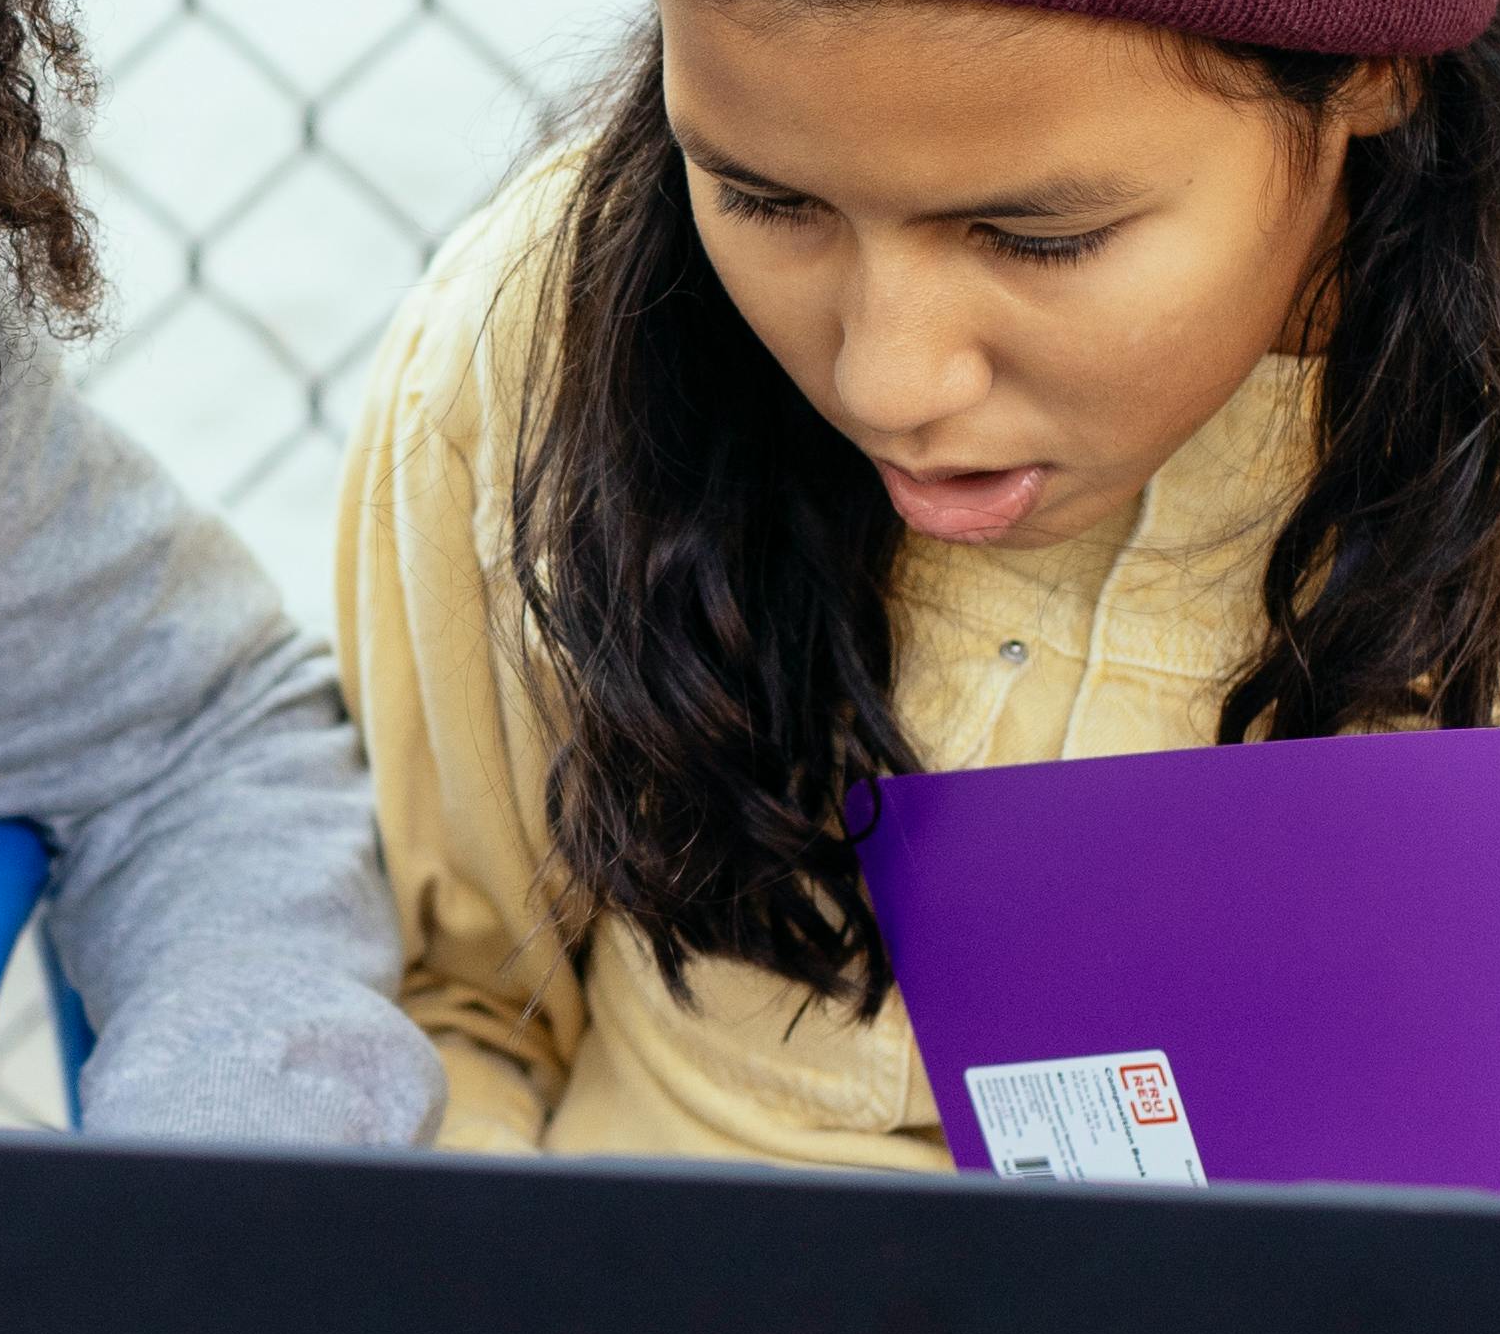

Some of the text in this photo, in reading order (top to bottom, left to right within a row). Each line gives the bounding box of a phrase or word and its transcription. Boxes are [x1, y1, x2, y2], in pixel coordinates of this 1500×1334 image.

[1132, 1075, 1152, 1112] RED
[1145, 1074, 1165, 1112] TRU
[1105, 1067, 1146, 1178] Composition Book
